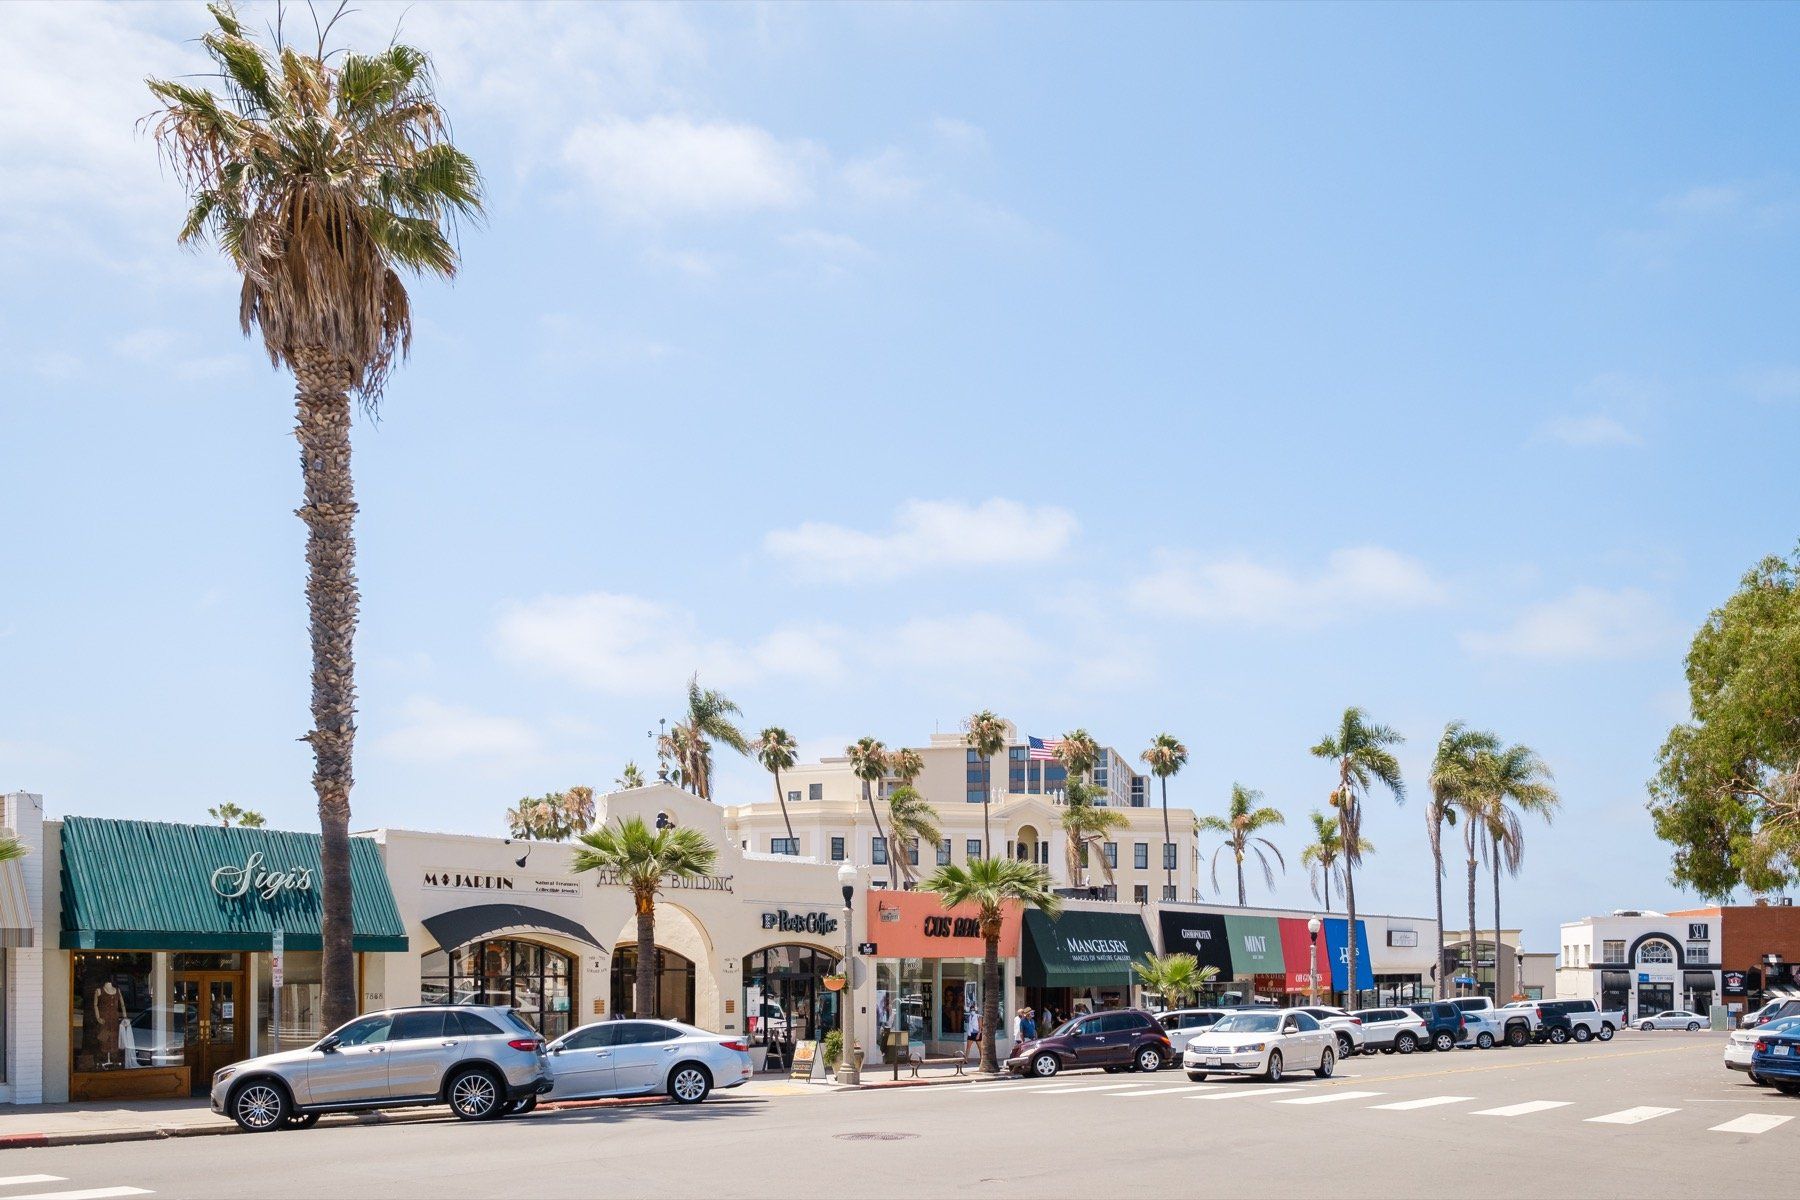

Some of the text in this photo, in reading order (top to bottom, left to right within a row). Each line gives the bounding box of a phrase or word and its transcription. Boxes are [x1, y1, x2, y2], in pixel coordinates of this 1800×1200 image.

[211, 851, 314, 900] Sigi's
[452, 874, 513, 890] JARDIN
[671, 874, 733, 891] BUILDING
[806, 912, 837, 935] Coffee
[924, 916, 952, 938] COS
[1692, 924, 1705, 939] SEV
[1066, 937, 1128, 953] MANGELSEN
[1244, 935, 1267, 953] MINT
